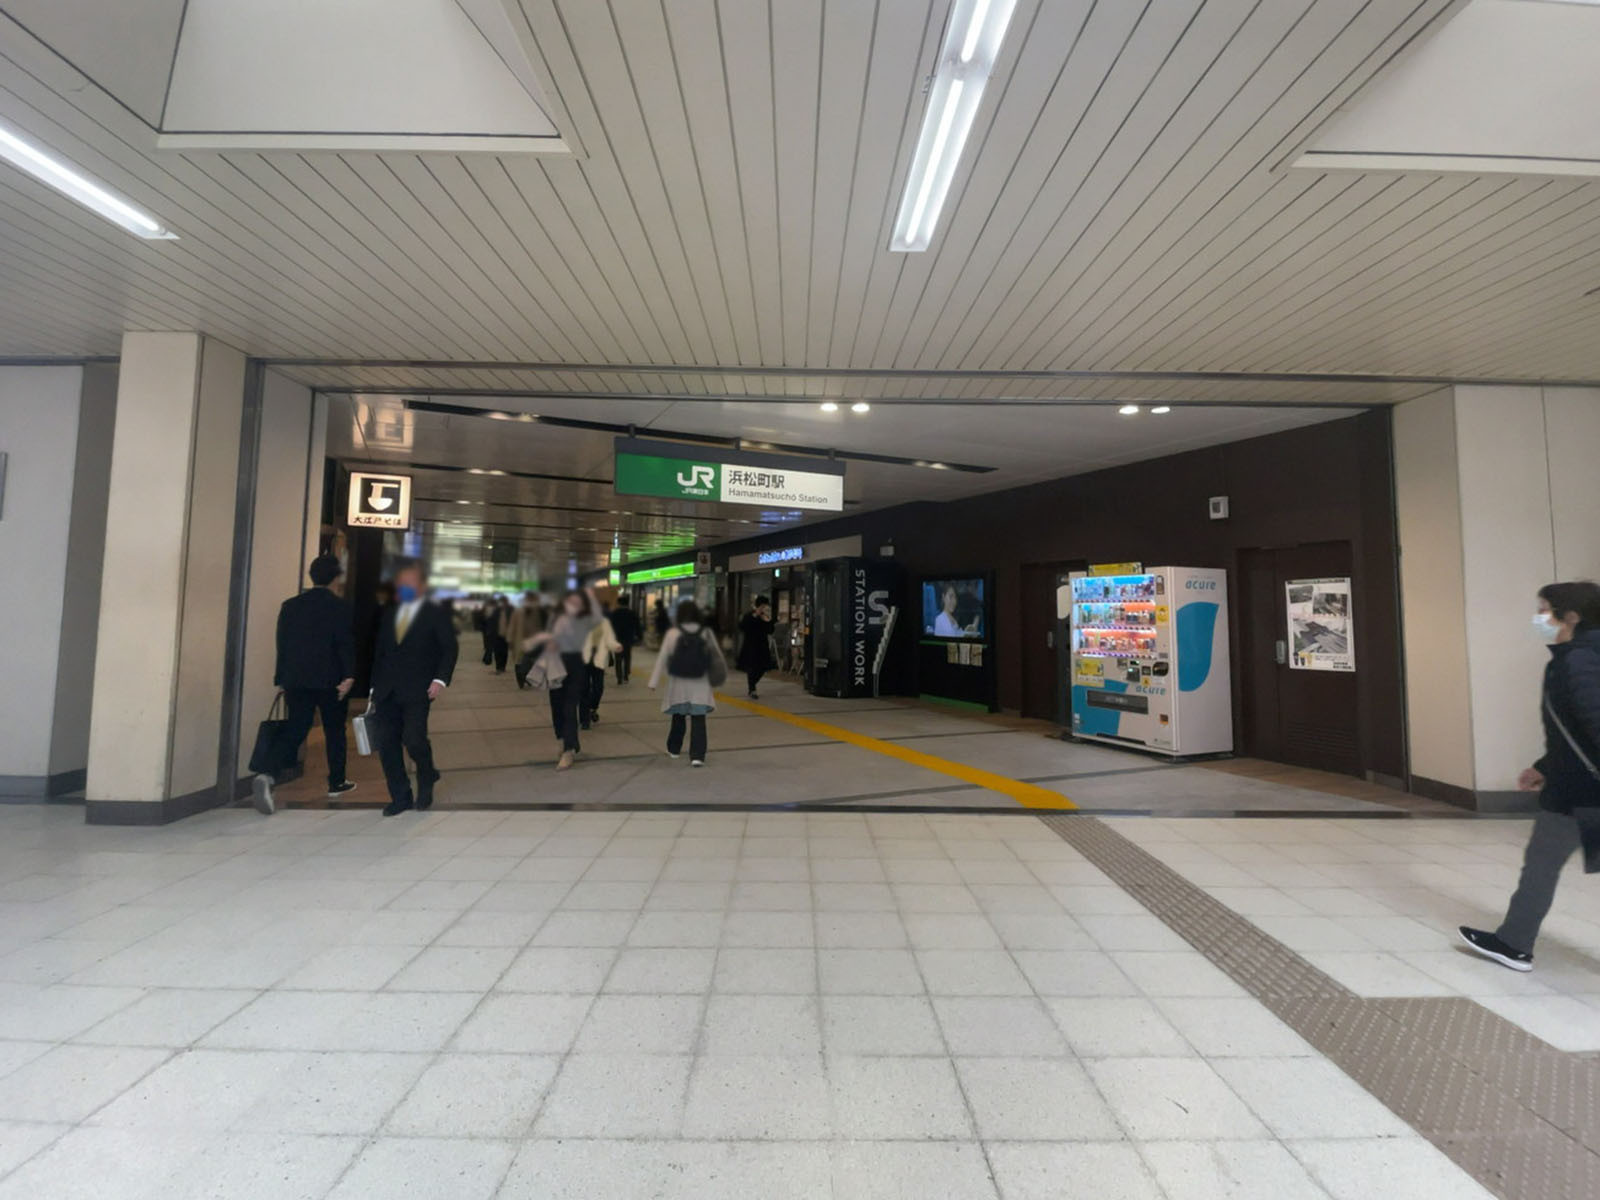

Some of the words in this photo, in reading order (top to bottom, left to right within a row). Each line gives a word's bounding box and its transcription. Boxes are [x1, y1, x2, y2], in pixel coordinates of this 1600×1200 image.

[677, 465, 715, 489] JR
[728, 469, 785, 489] 浜松町駅
[798, 493, 828, 504] Station
[1185, 579, 1217, 591] acure
[854, 569, 866, 634] STATION
[854, 640, 866, 686] WORK
